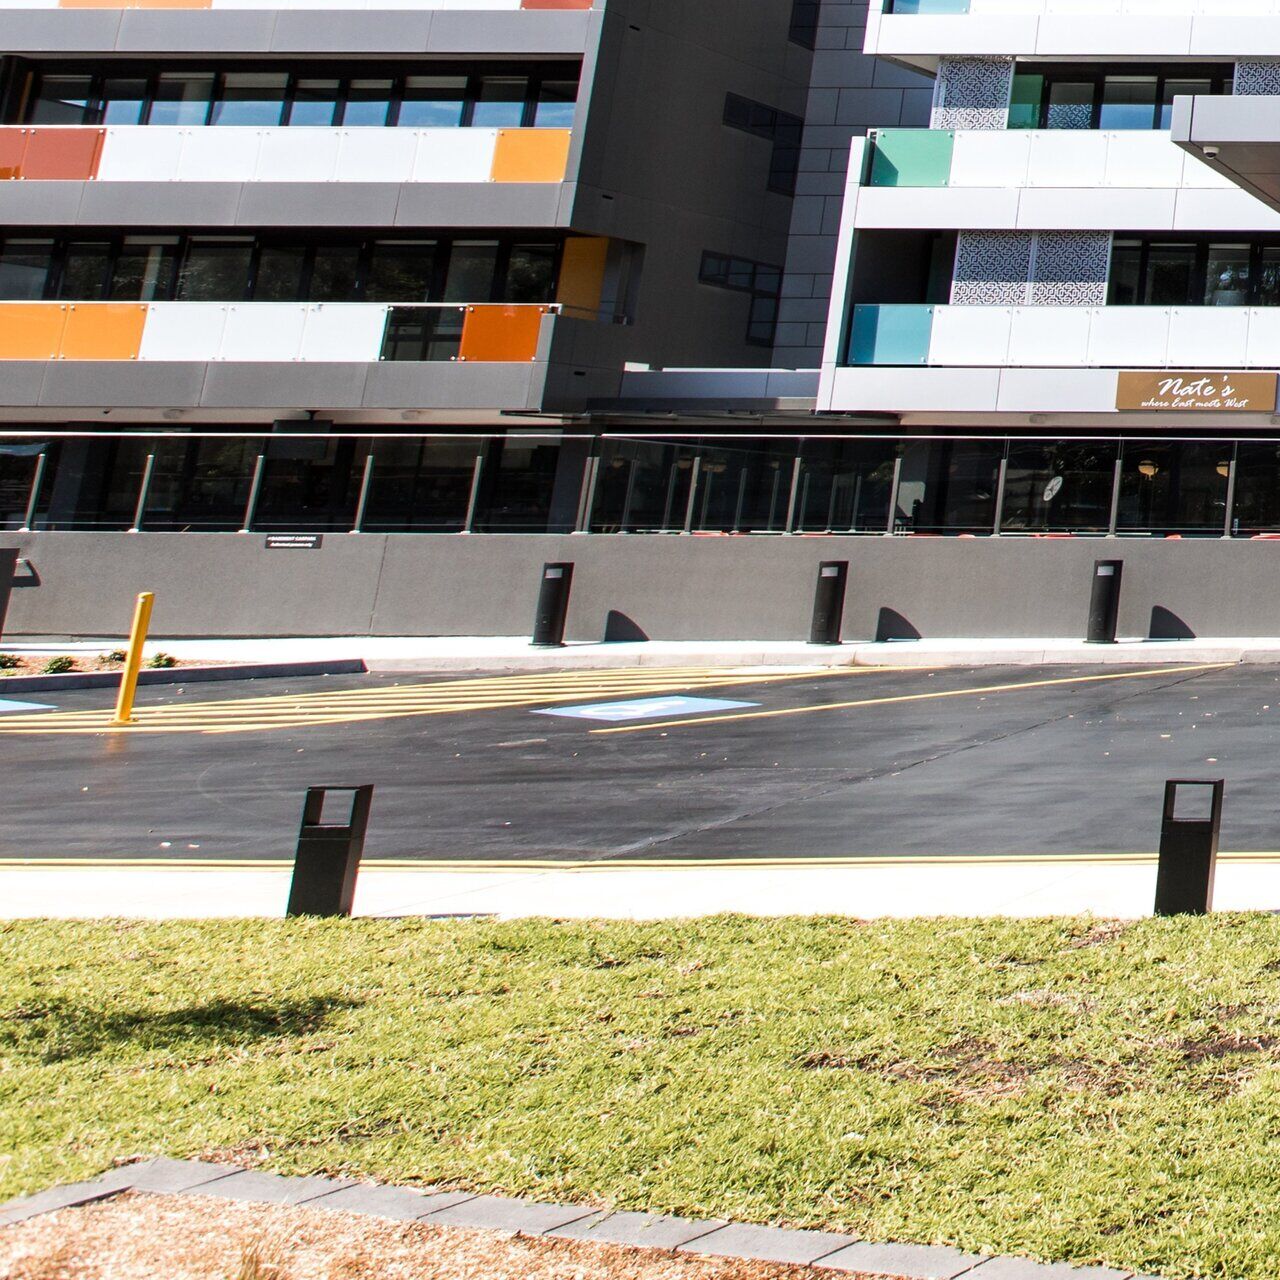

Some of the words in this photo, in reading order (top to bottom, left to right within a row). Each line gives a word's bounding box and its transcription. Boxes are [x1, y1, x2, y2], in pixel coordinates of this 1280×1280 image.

[1158, 375, 1235, 397] Nate's
[1141, 397, 1170, 408] where
[1171, 397, 1195, 408] East
[1224, 397, 1249, 408] West
